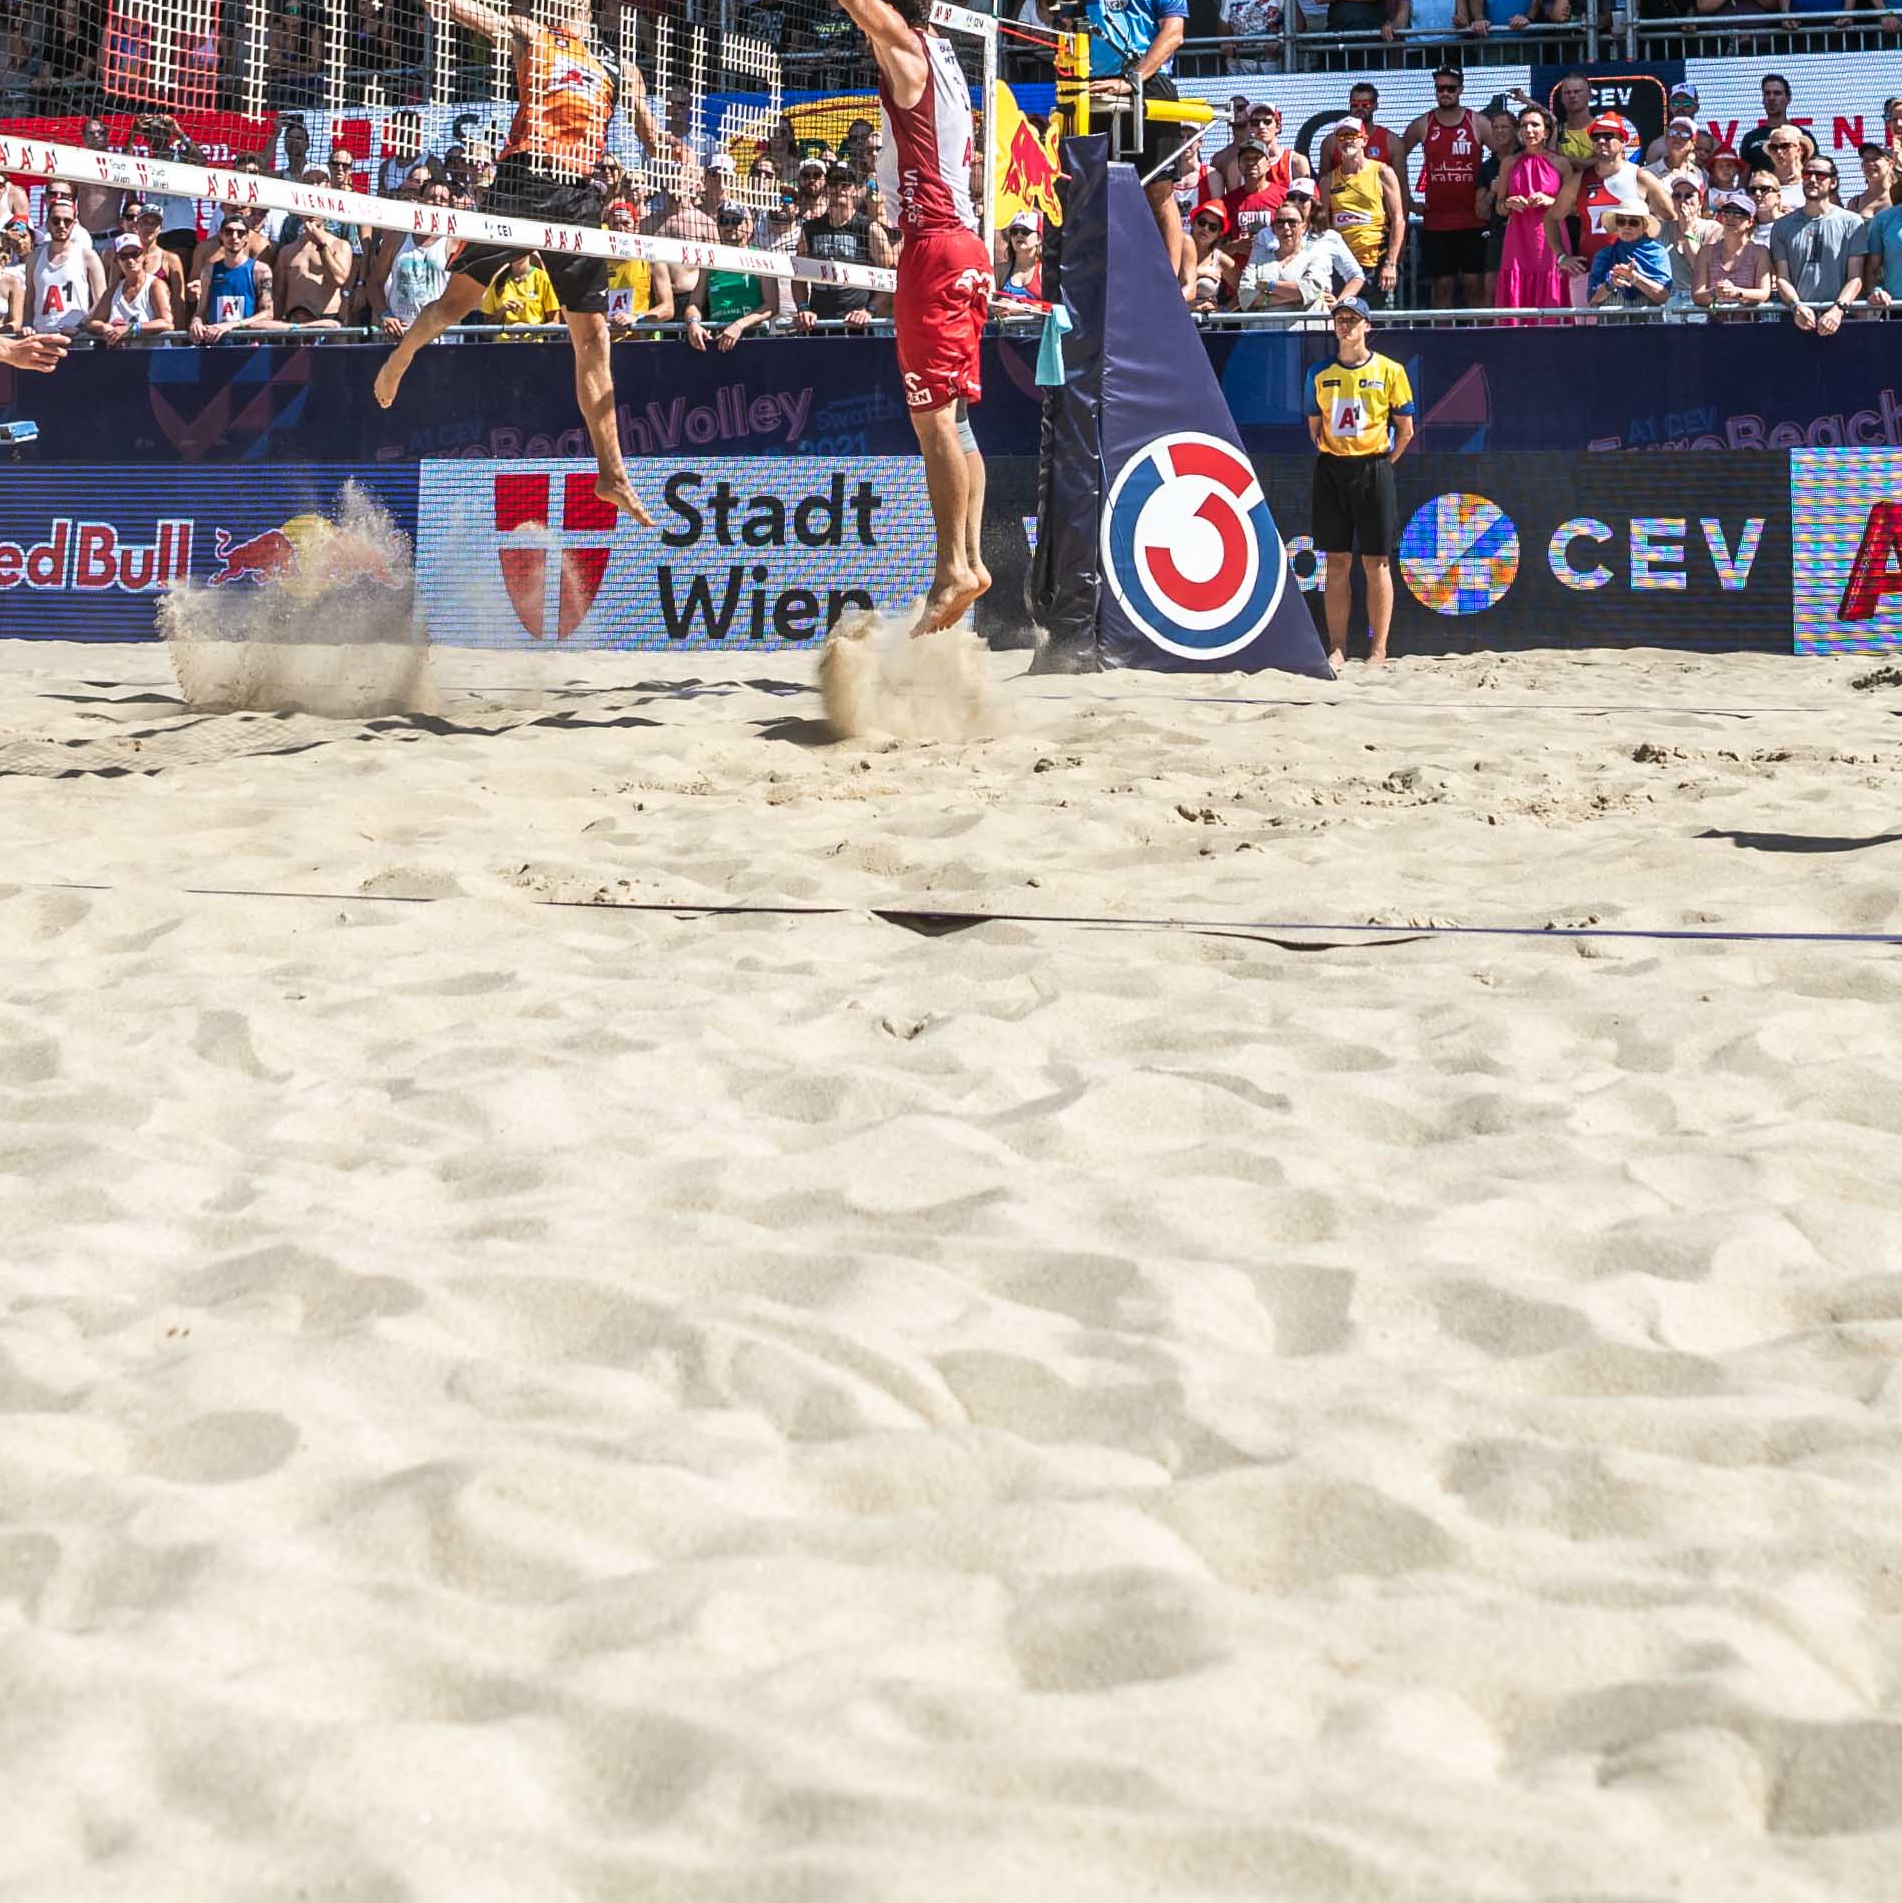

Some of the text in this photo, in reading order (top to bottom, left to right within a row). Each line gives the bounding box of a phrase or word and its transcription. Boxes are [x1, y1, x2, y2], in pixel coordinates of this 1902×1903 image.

[1451, 141, 1472, 156] AUT
[1456, 128, 1467, 140] 2
[19, 145, 34, 170] A1
[43, 149, 58, 174] A1
[207, 173, 262, 203] A1 A1 A1
[43, 281, 73, 315] A1
[221, 300, 241, 319] A1
[610, 292, 628, 311] A1
[1338, 405, 1361, 430] A1
[659, 473, 884, 549] Stadt
[74, 519, 191, 592] Bull
[1547, 516, 1766, 592] CEV
[659, 565, 874, 640] Wien
